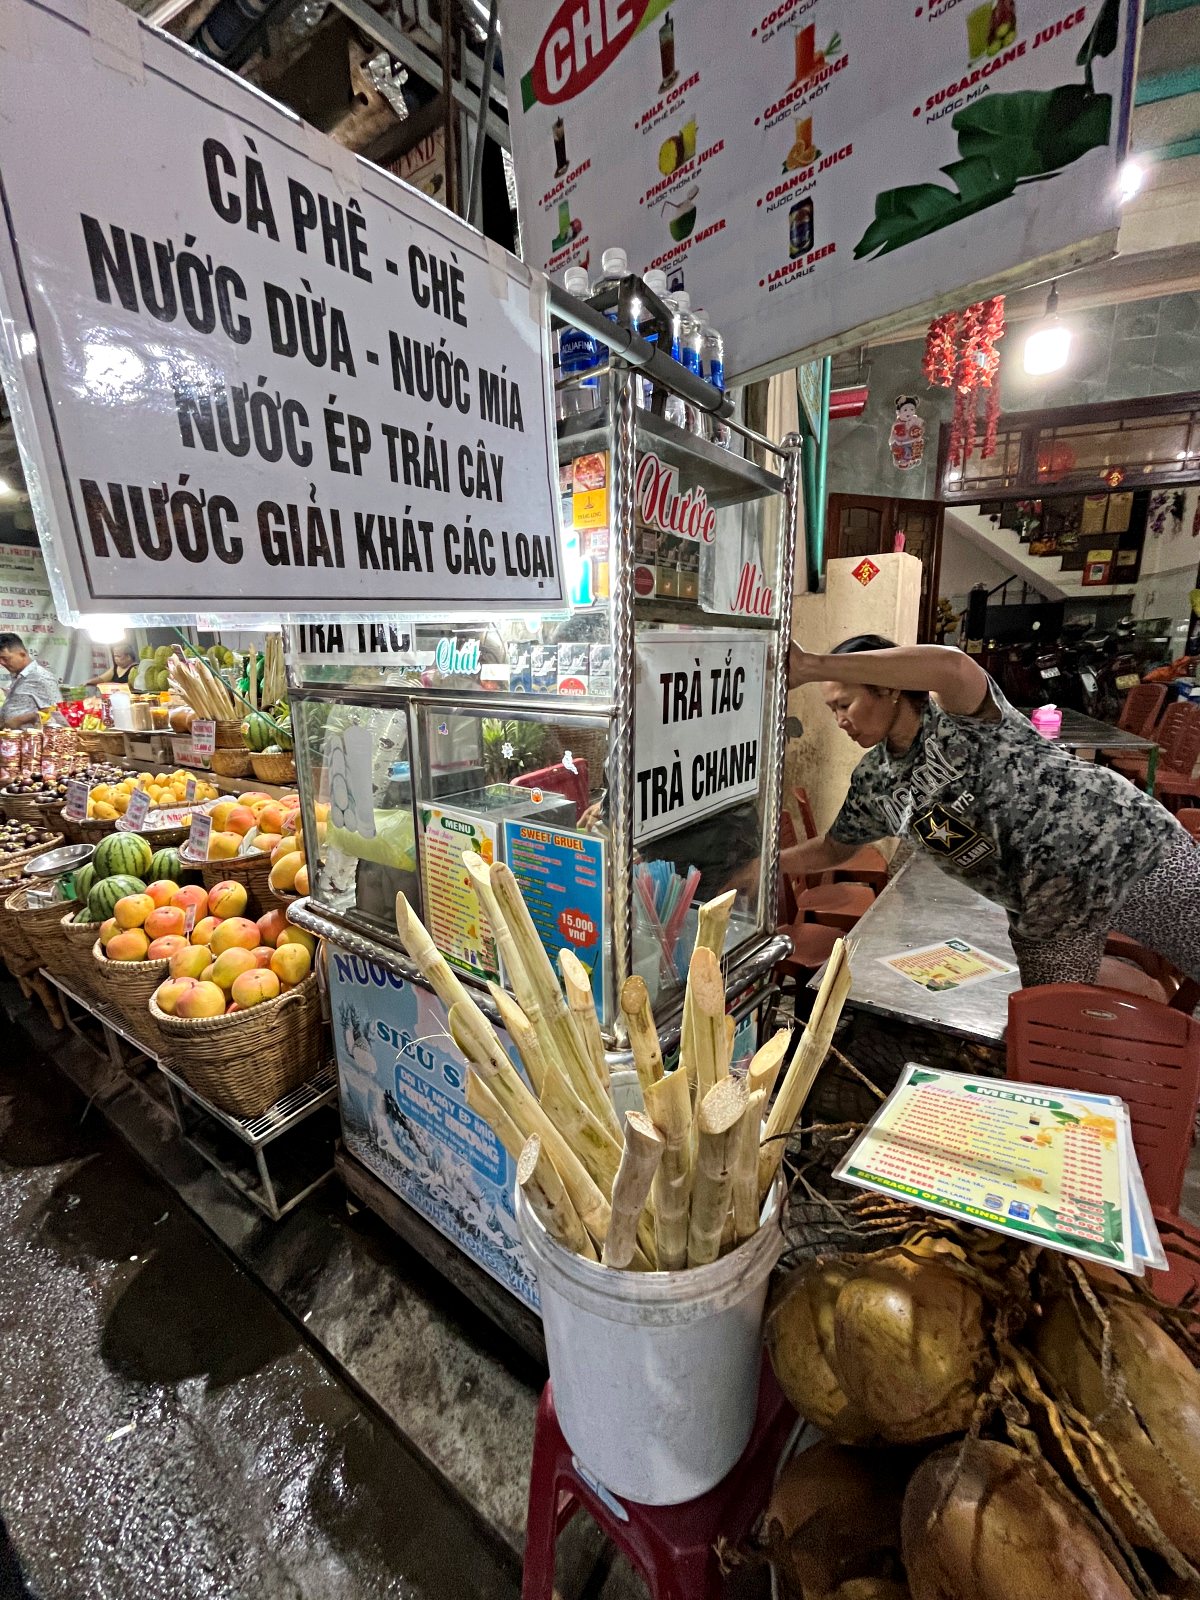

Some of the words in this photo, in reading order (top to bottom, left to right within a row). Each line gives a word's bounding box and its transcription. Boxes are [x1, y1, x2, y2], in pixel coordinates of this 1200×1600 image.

[925, 40, 1027, 111] SUGARCANE
[1032, 6, 1086, 49] JUICE
[641, 100, 663, 125] MILK
[667, 71, 700, 104] COFFEE
[764, 81, 810, 119] CARROT
[812, 54, 848, 88] JUICE
[543, 180, 564, 203] BLACK
[566, 158, 591, 184] COFFEE
[646, 160, 695, 201] PINEAPPLE
[697, 139, 725, 165] JUICE
[766, 166, 814, 202] ORANGE
[818, 143, 853, 173] JUICE
[795, 180, 817, 196] CAM
[203, 136, 279, 243] CÀ
[287, 175, 373, 283] PHÊ
[409, 243, 468, 328] CHÈ
[650, 238, 692, 270] COCONUT
[695, 219, 726, 244] WATER
[768, 258, 803, 283] LARUE
[807, 242, 836, 265] BEER
[769, 281, 783, 292] BIA
[785, 265, 816, 285] LARUE
[80, 212, 252, 345] NƯỚC
[264, 278, 357, 378] DỪA
[389, 329, 470, 415] NƯỚC
[479, 364, 524, 433] MÍA
[561, 341, 594, 354] AQUAFINA
[173, 375, 313, 468] NƯỚC
[324, 394, 371, 476] ÉP
[382, 422, 449, 494] TRÁI
[457, 440, 504, 503] CÂY
[80, 473, 245, 564] NƯỚC
[257, 482, 345, 568] GIẢI
[354, 505, 434, 573] KHÁT
[443, 512, 496, 576] CÁC
[502, 531, 555, 588] LOẠI
[660, 658, 702, 724] TRÀ
[711, 649, 745, 715] TẮC
[637, 749, 684, 822] TRÀ
[692, 740, 757, 801] CHANH
[951, 790, 975, 814] 1775
[445, 819, 471, 834] MENU
[520, 828, 552, 844] SWEET
[554, 836, 585, 852] GRUEL
[561, 912, 593, 933] 15.000
[569, 929, 586, 942] vnd
[376, 1021, 434, 1070] SIÊU
[975, 1086, 1050, 1107] MENU
[874, 1167, 906, 1179] LARUE
[909, 1178, 934, 1189] BEER
[879, 1160, 907, 1172] TIGER
[910, 1170, 935, 1180] BEER
[886, 1147, 945, 1167] SUGARCANE
[948, 1166, 977, 1177] JUICE
[934, 1169, 952, 1177] TEA
[857, 1171, 919, 1195] BEVERAGES
[922, 1192, 937, 1201] OF
[941, 1198, 961, 1209] ALL
[966, 1206, 1007, 1223] KINDS
